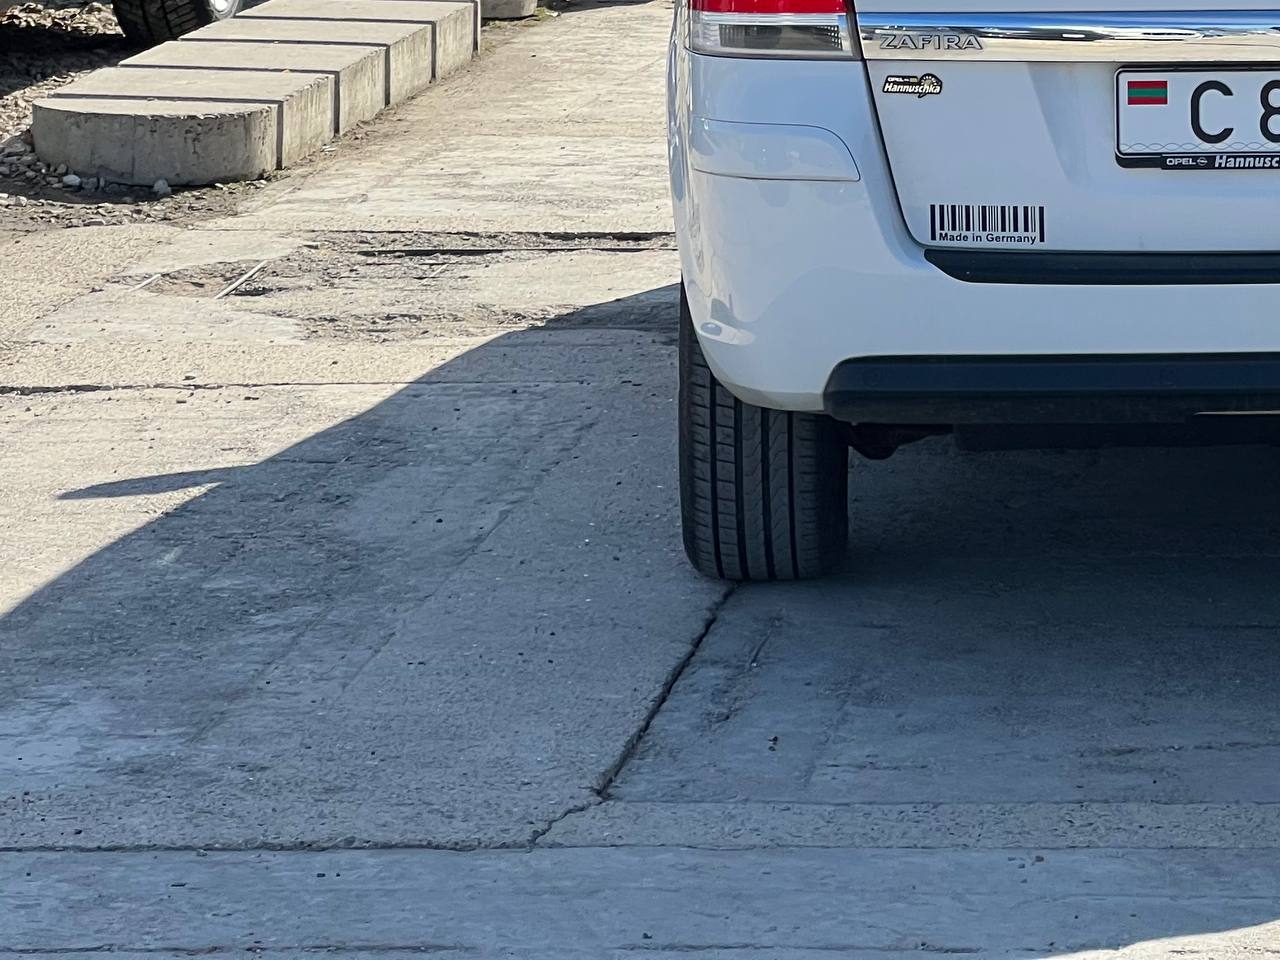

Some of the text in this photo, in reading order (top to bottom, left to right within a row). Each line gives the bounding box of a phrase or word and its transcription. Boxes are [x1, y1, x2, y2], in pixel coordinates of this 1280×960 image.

[880, 34, 983, 50] ZAFIRA
[884, 83, 940, 93] Hannuschka
[1190, 80, 1235, 144] C
[1166, 157, 1197, 166] OPEL
[939, 233, 1036, 245] Made in Germany
